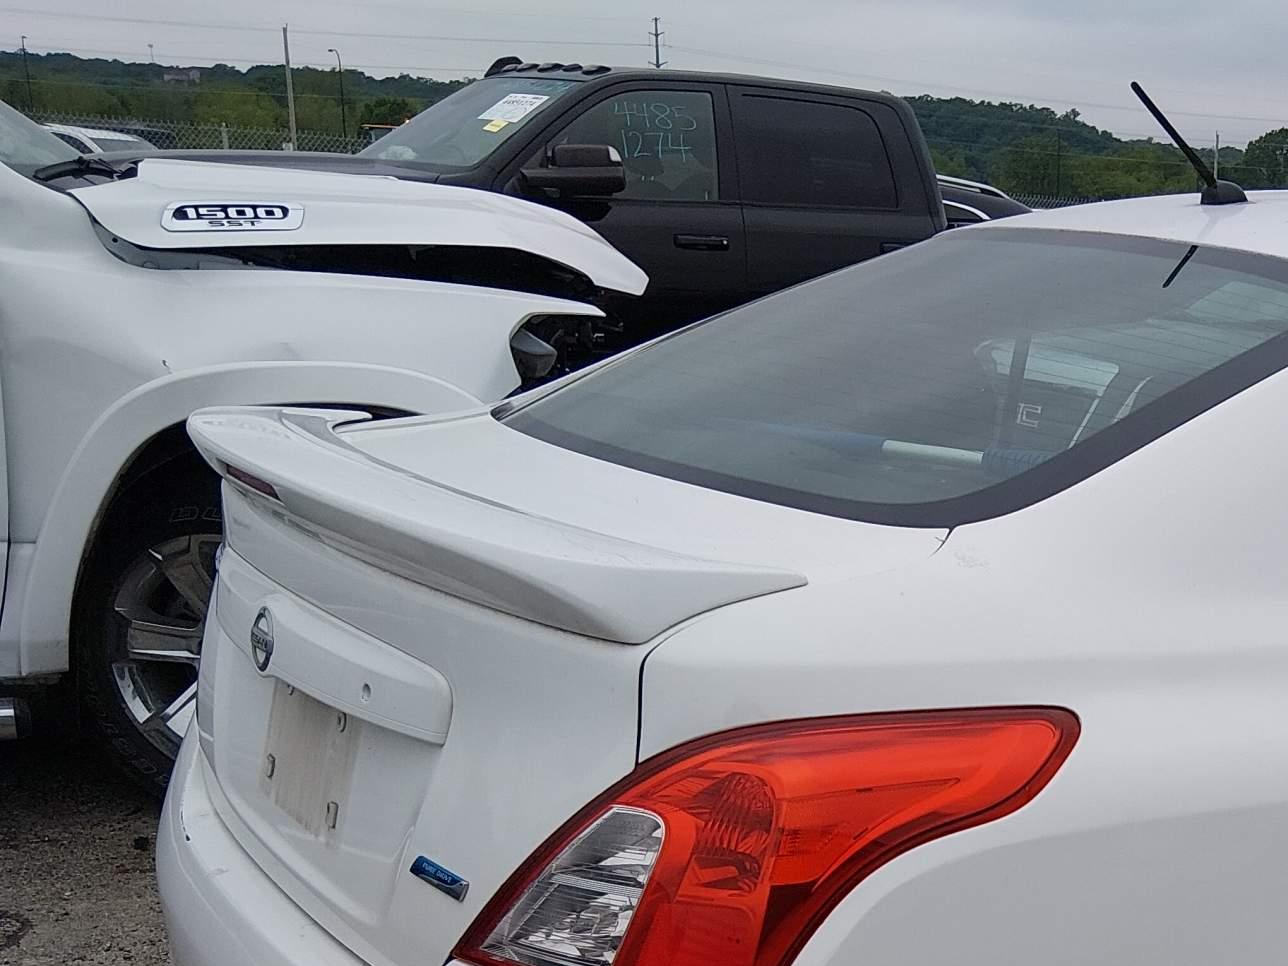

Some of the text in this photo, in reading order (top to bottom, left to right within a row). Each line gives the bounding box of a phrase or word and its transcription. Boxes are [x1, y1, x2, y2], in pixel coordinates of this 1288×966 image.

[613, 101, 697, 131] 4485
[621, 129, 692, 161] 1274
[182, 207, 285, 220] 1500
[207, 220, 263, 228] SST
